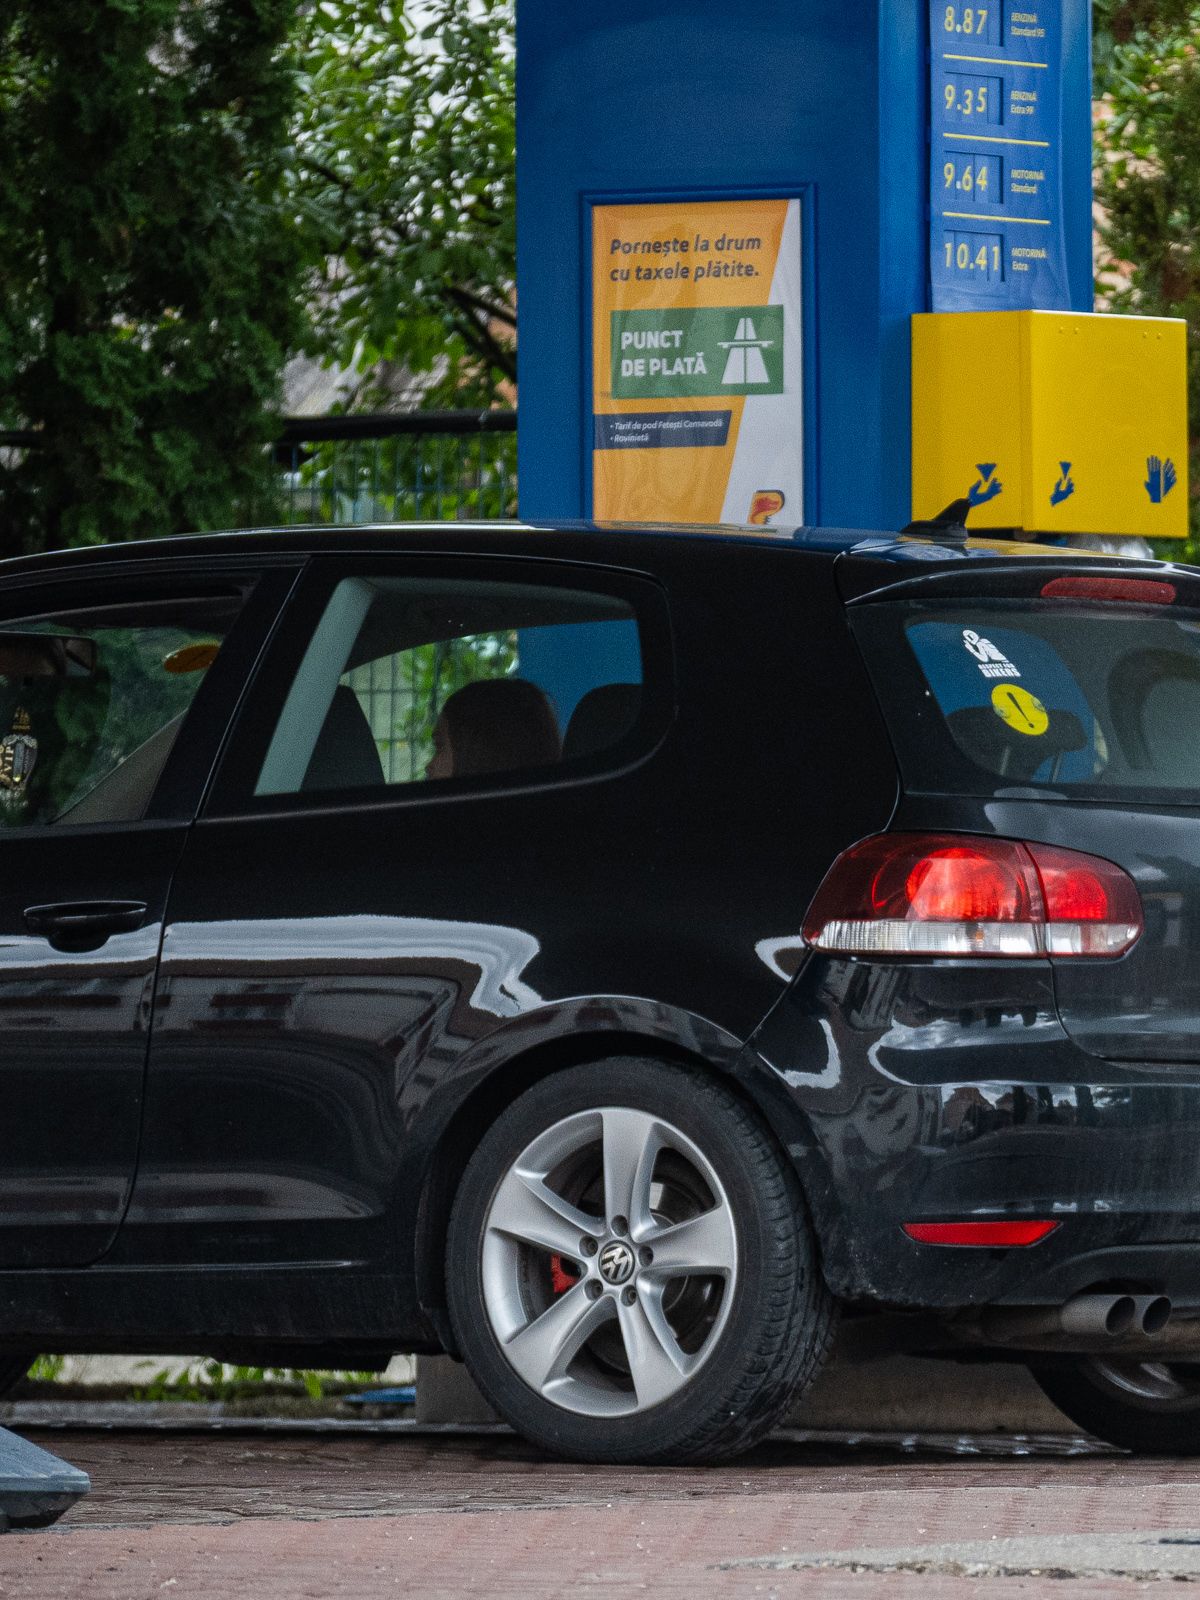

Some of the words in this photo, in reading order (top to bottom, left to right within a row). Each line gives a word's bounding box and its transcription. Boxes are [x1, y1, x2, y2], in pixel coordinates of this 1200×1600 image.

[944, 6, 987, 34] 8.87
[944, 84, 987, 115] 9.35
[1010, 104, 1026, 114] Extra
[944, 162, 988, 192] 9.64
[610, 236, 690, 257] Pornește
[694, 234, 710, 252] la
[714, 233, 762, 252] drum
[945, 242, 1000, 271] 10.41
[610, 267, 630, 281] cu
[634, 261, 690, 281] taxele
[693, 259, 760, 282] plătite.
[1012, 260, 1028, 271] Extra
[620, 329, 684, 350] PUNCT
[620, 358, 646, 377] DE
[649, 352, 708, 376] PLATĂ
[614, 422, 632, 430] Tarif
[631, 422, 641, 430] de
[642, 421, 657, 431] pod
[981, 669, 1021, 677] BIKERS
